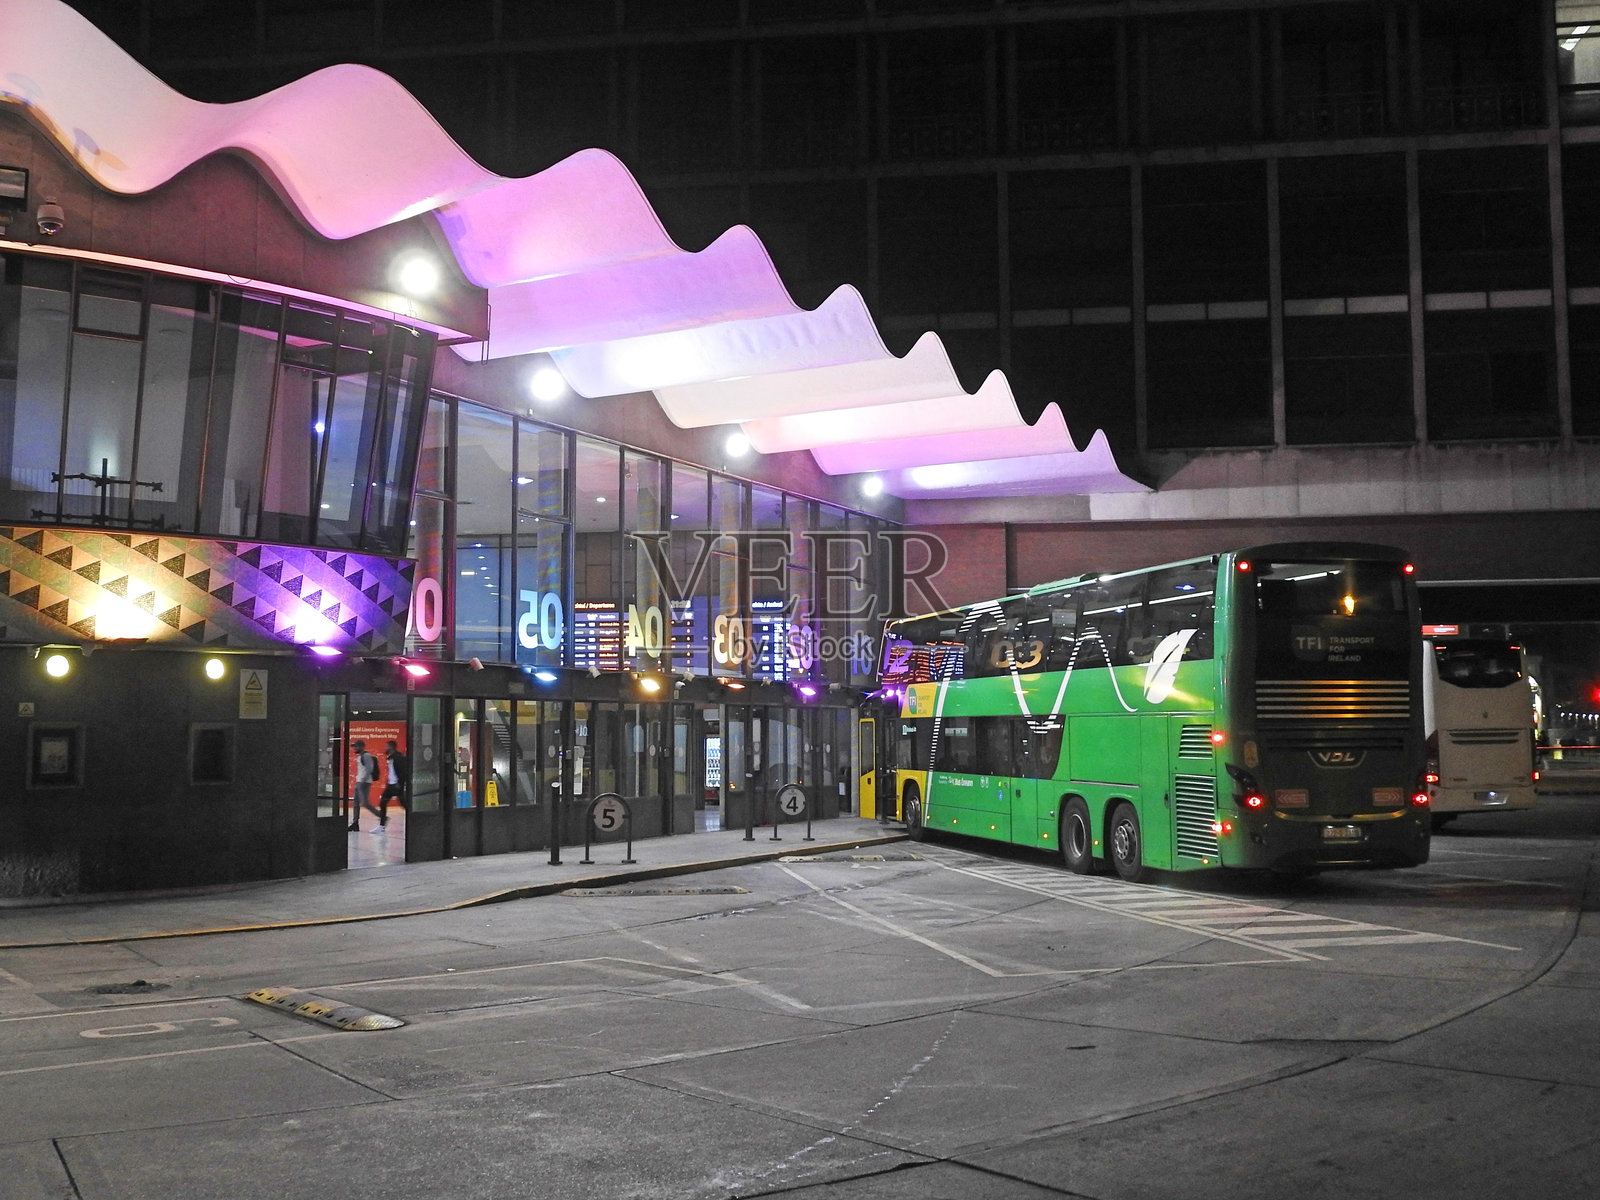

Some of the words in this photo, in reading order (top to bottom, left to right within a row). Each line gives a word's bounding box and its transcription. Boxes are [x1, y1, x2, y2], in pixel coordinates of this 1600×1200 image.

[1296, 636, 1322, 650] TFI
[1329, 636, 1375, 644] TRANSPORT
[1318, 751, 1356, 762] VDL
[786, 796, 799, 812] 4
[602, 808, 616, 829] 5
